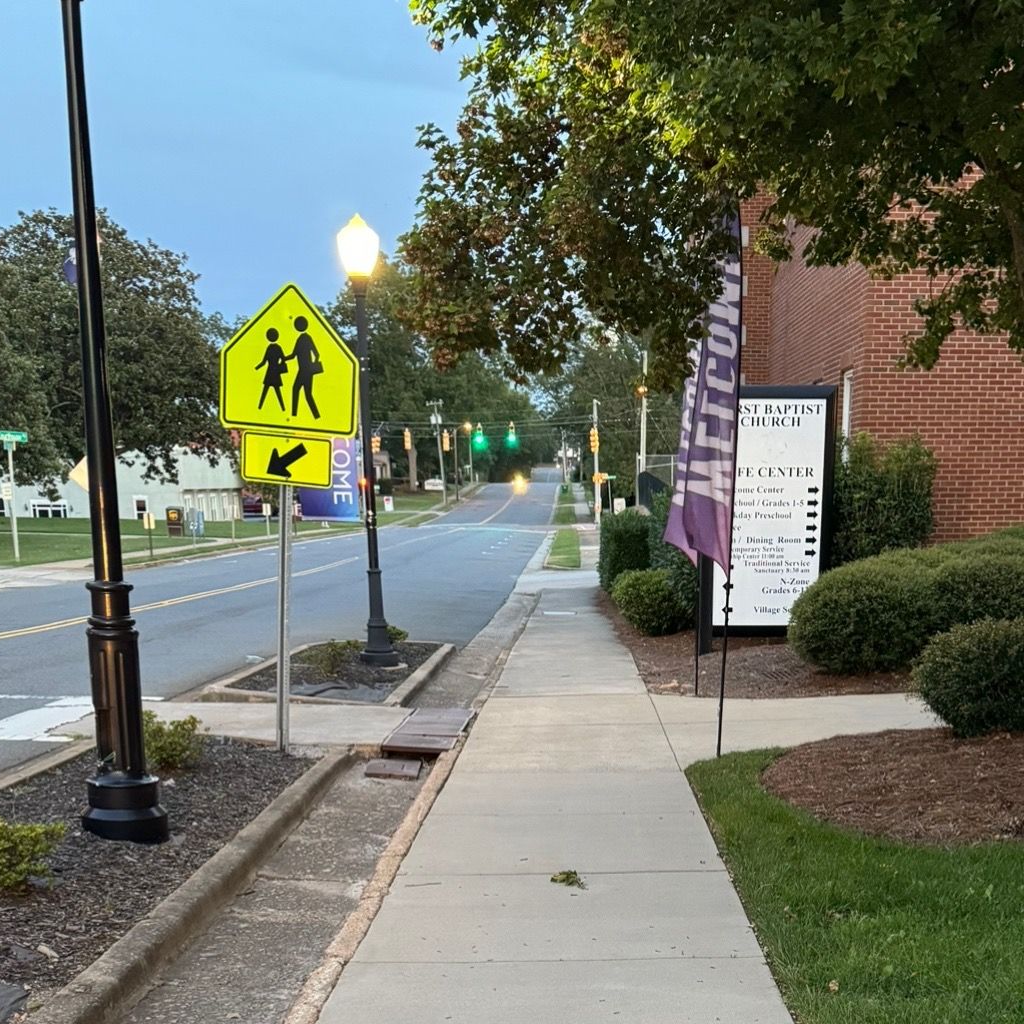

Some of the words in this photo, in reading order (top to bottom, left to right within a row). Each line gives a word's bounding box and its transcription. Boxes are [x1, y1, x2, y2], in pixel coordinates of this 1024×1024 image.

[764, 404, 823, 415] BAPTIST
[740, 416, 801, 428] CHURCH
[758, 467, 814, 478] CENTER
[756, 486, 784, 494] Center
[755, 511, 792, 519] Preschool
[746, 536, 773, 545] Dining
[777, 536, 801, 544] Room
[732, 547, 760, 555] mporary
[754, 606, 780, 615] Village
